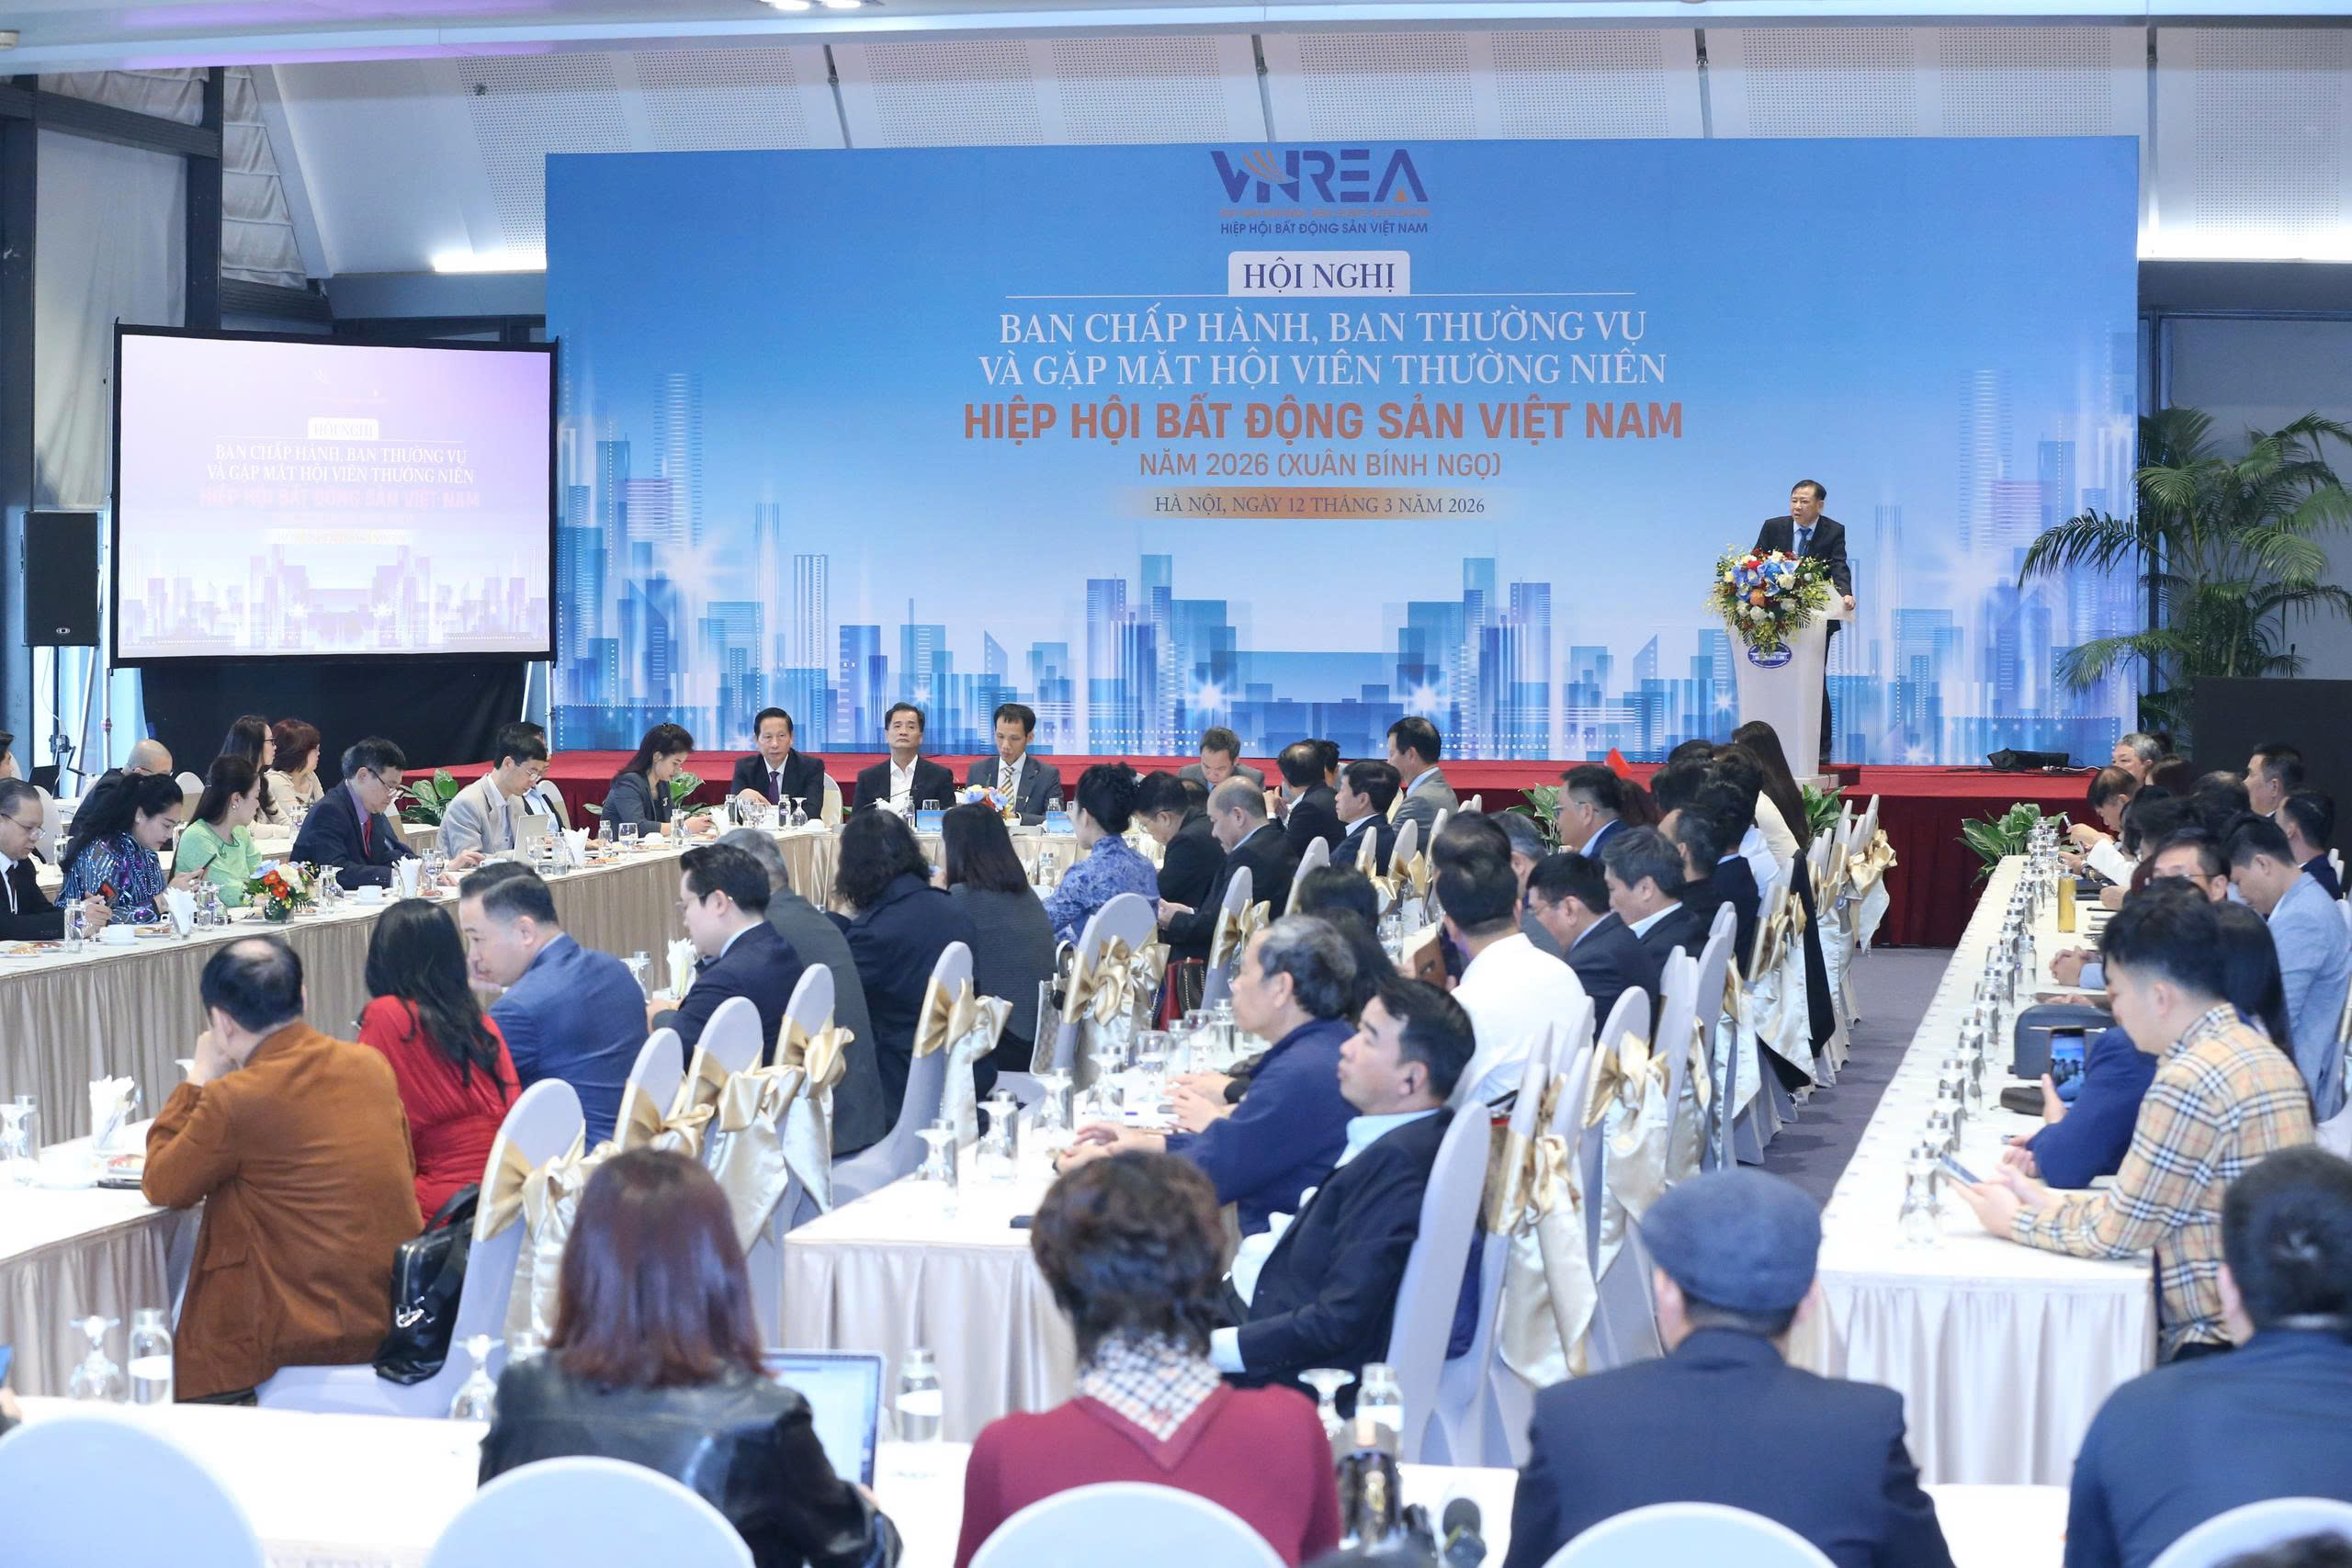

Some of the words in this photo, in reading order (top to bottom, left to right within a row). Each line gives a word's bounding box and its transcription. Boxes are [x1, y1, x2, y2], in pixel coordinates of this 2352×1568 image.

[1210, 149, 1429, 204] VNREA
[1221, 220, 1246, 236] HIỆP
[1250, 220, 1272, 236] HỘI
[1275, 220, 1296, 233] BẤT
[1299, 220, 1339, 236] ĐỘNG
[1342, 220, 1366, 233] SẢN
[1370, 220, 1396, 236] VIỆT
[1398, 222, 1428, 233] NAM
[1243, 256, 1303, 293] HỘI
[1312, 263, 1395, 293] NGHỊ
[1000, 313, 1073, 344] BAN
[1085, 302, 1188, 344] CHẤP
[1198, 306, 1317, 345] HÀNH,
[1329, 312, 1405, 342] BAN
[1416, 305, 1585, 342] THƯỜNG
[1593, 311, 1646, 346] VỤ
[978, 349, 1023, 386] VÀ
[1033, 349, 1107, 390] GẶP
[1117, 349, 1199, 390] MẶT
[1210, 346, 1280, 390] HỘI
[1290, 348, 1381, 385] VIÊN
[1392, 347, 1561, 384] THƯỜNG
[1570, 347, 1667, 384] NIÊN
[965, 394, 1057, 445] HIỆP
[1071, 394, 1140, 445] HỘI
[1157, 392, 1232, 439] BẤT
[1244, 393, 1363, 446] ĐỘNG
[1377, 393, 1464, 440] SẢN
[1477, 393, 1571, 446] VIỆT
[1586, 402, 1683, 439] NAM
[216, 443, 247, 460] BAN
[346, 447, 376, 462] BAN
[1140, 448, 1196, 476] NĂM
[1205, 453, 1269, 476] 2026
[1277, 448, 1357, 476] (XUÂN
[1366, 447, 1428, 476] BÍNH
[1437, 452, 1501, 479] NGỌ)
[1155, 493, 1182, 513] HÀ
[1187, 492, 1227, 515] NỘI,
[1233, 492, 1283, 513] NGÀY
[1289, 496, 1306, 513] 12
[1309, 493, 1378, 513] THÁNG
[1384, 496, 1393, 513] 3
[1398, 494, 1443, 513] NĂM
[1448, 497, 1486, 513] 2026
